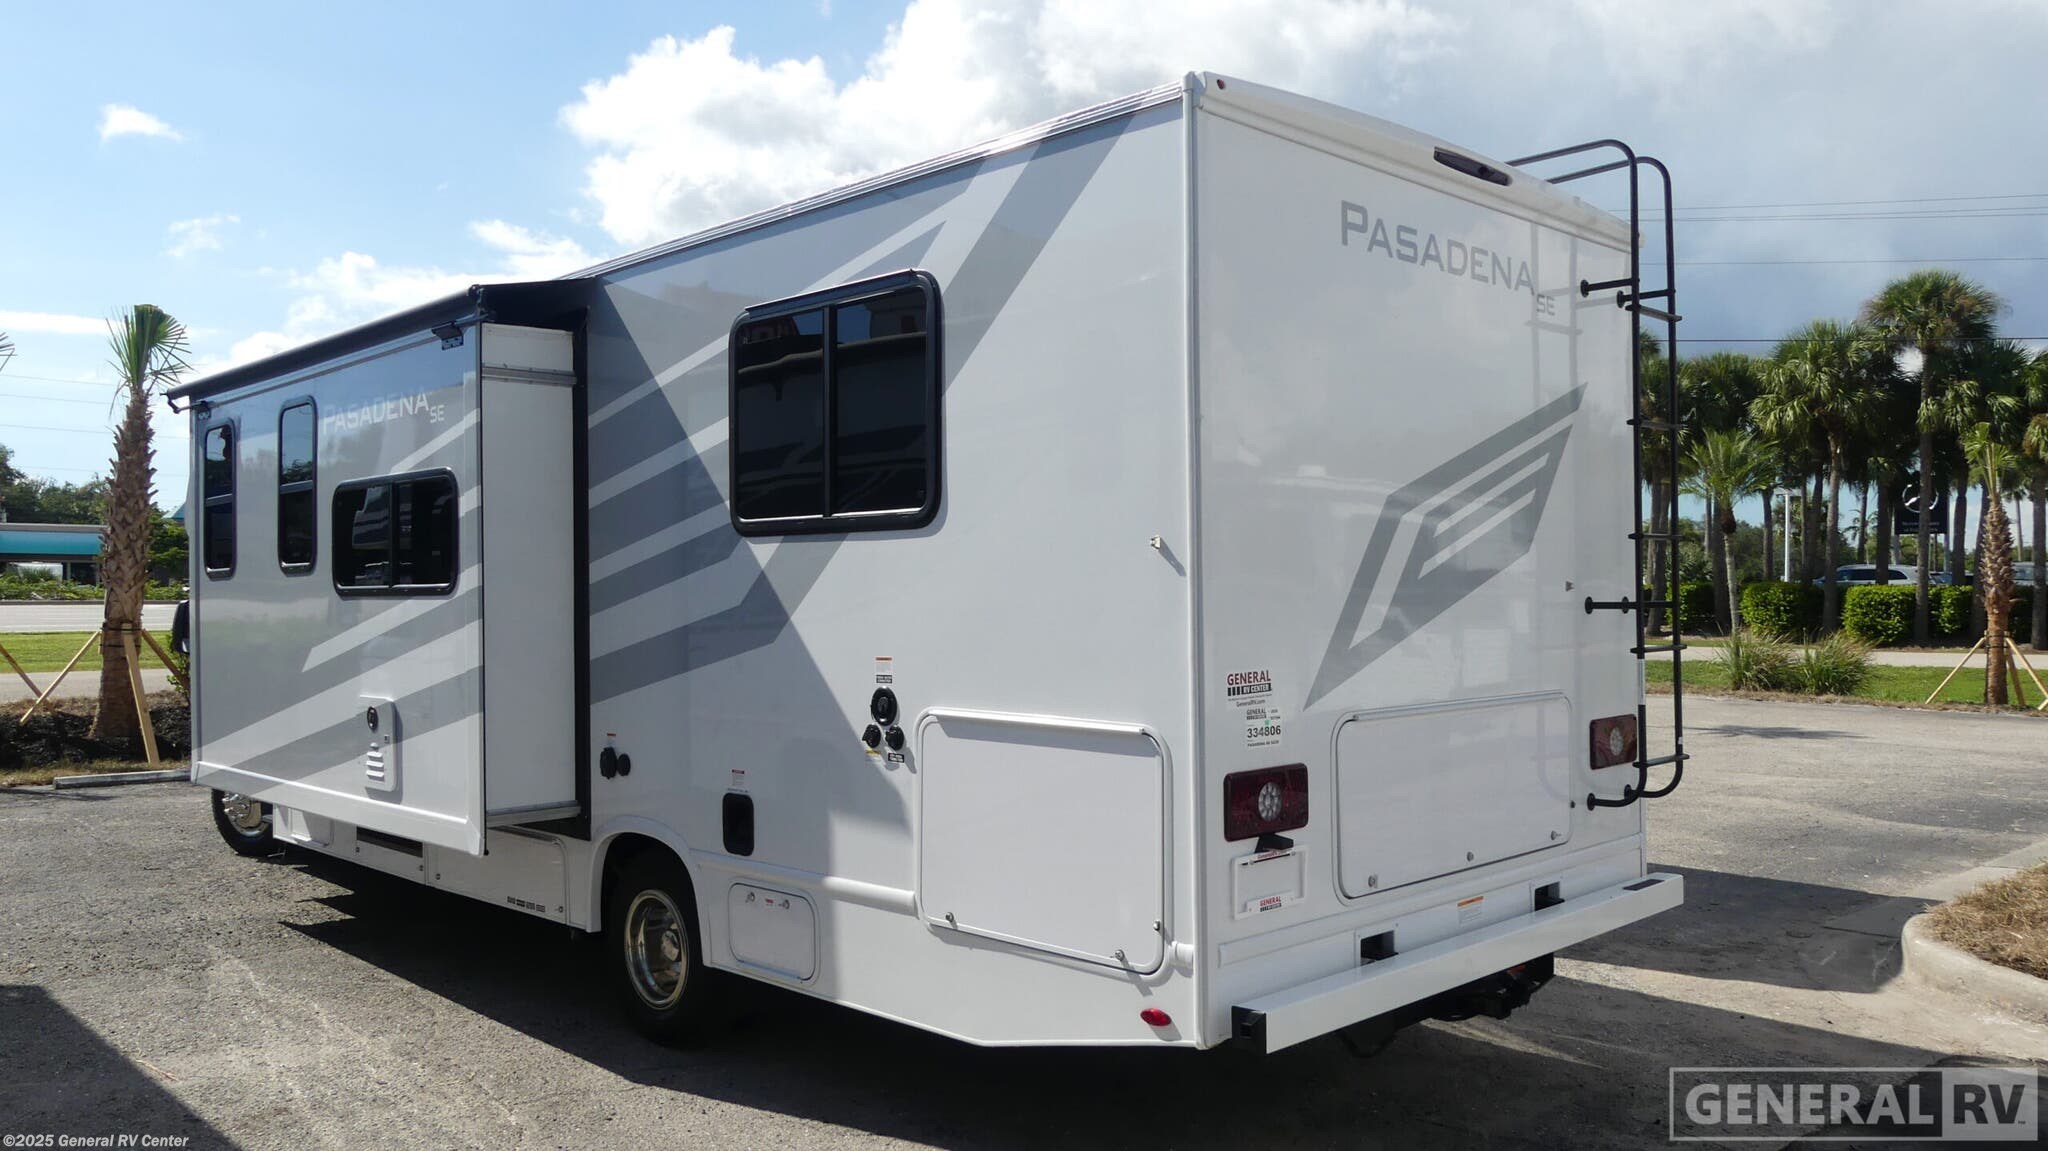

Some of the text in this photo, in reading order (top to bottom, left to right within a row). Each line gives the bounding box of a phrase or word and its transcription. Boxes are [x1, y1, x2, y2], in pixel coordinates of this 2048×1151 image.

[1341, 200, 1556, 316] PASADENA SE
[323, 391, 445, 434] PASADENA SE
[1227, 670, 1271, 686] GENERAL
[1251, 684, 1270, 693] CENTER
[1247, 725, 1281, 738] 334806
[1260, 896, 1281, 907] GENERAL
